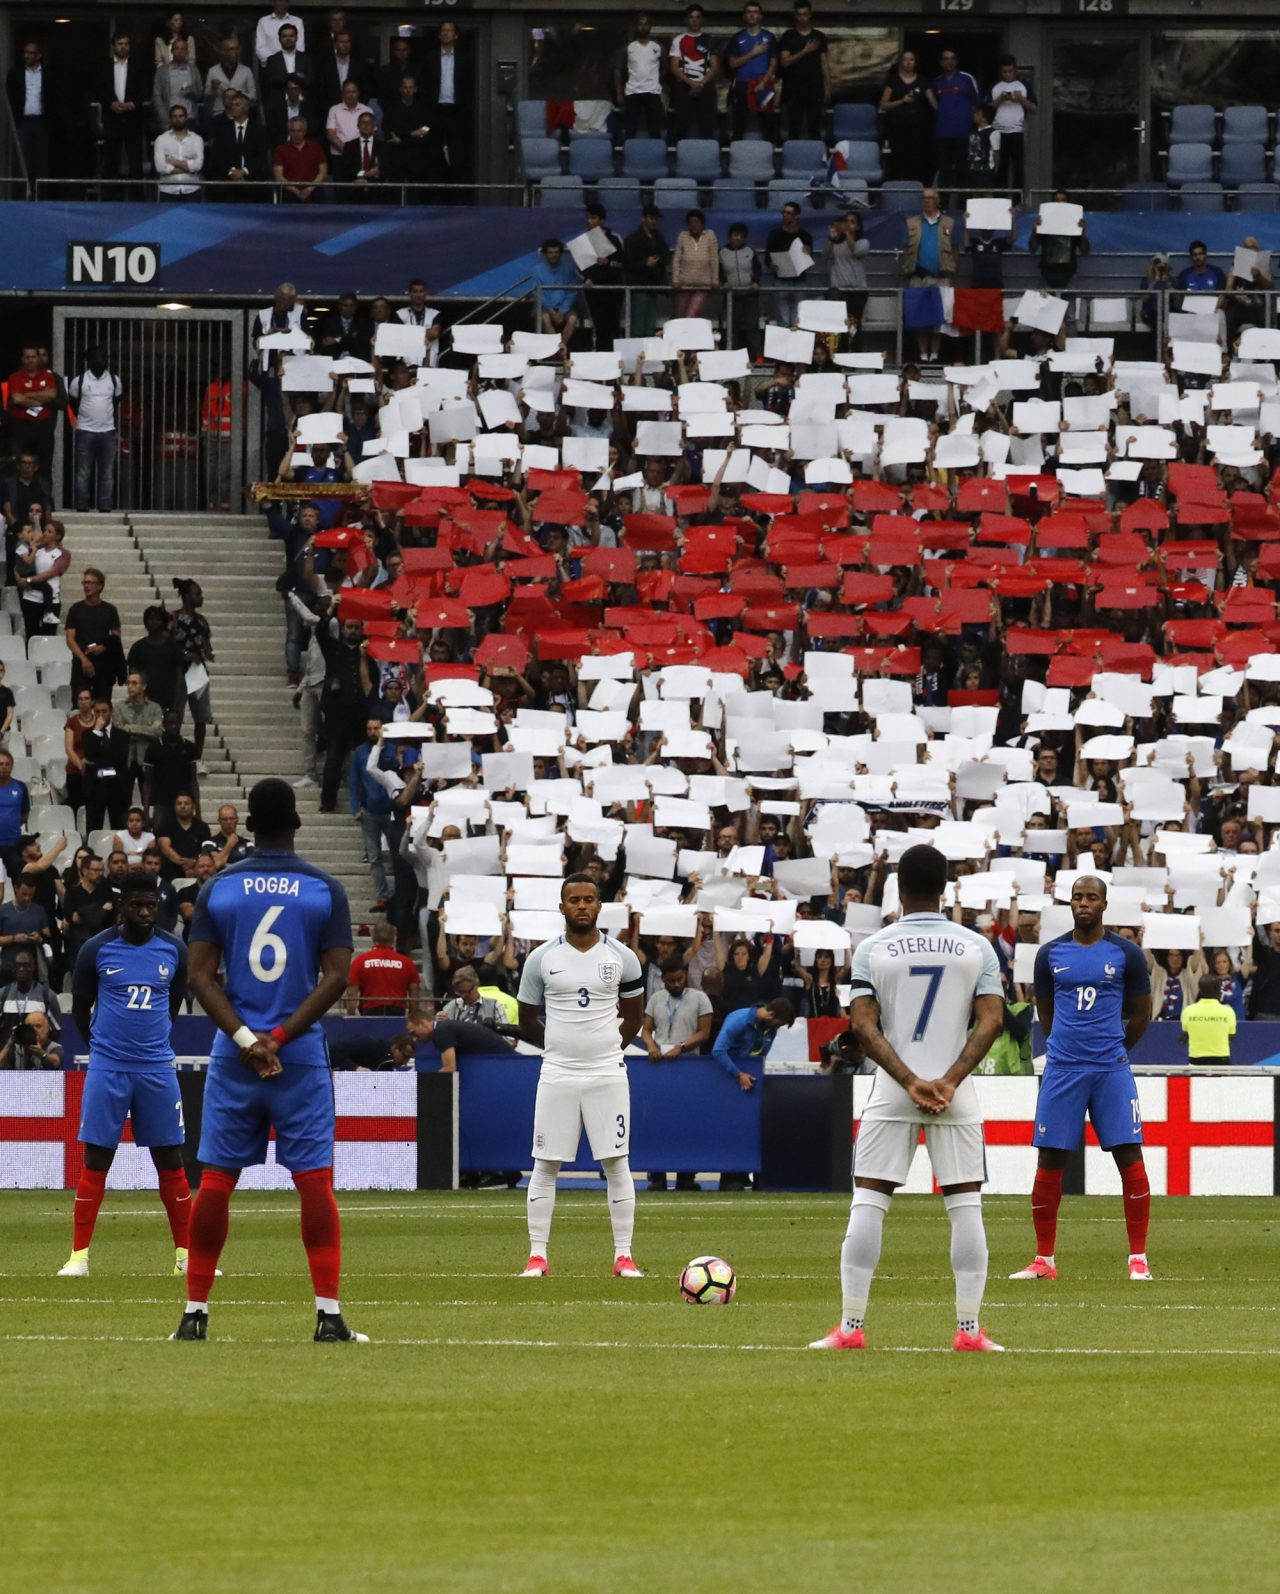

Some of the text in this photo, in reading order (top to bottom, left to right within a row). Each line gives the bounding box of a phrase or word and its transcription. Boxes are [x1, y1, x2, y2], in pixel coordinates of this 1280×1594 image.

[73, 246, 157, 284] N10
[242, 876, 300, 897] POGBA
[248, 905, 288, 983] 6
[887, 936, 966, 958] STERLING
[363, 958, 403, 969] STEWARD
[127, 985, 152, 1009] 22
[577, 987, 591, 1008] 3
[908, 965, 946, 1043] 7
[1076, 986, 1097, 1011] 19
[1188, 1015, 1229, 1024] SECURITE
[616, 1114, 626, 1138] 3
